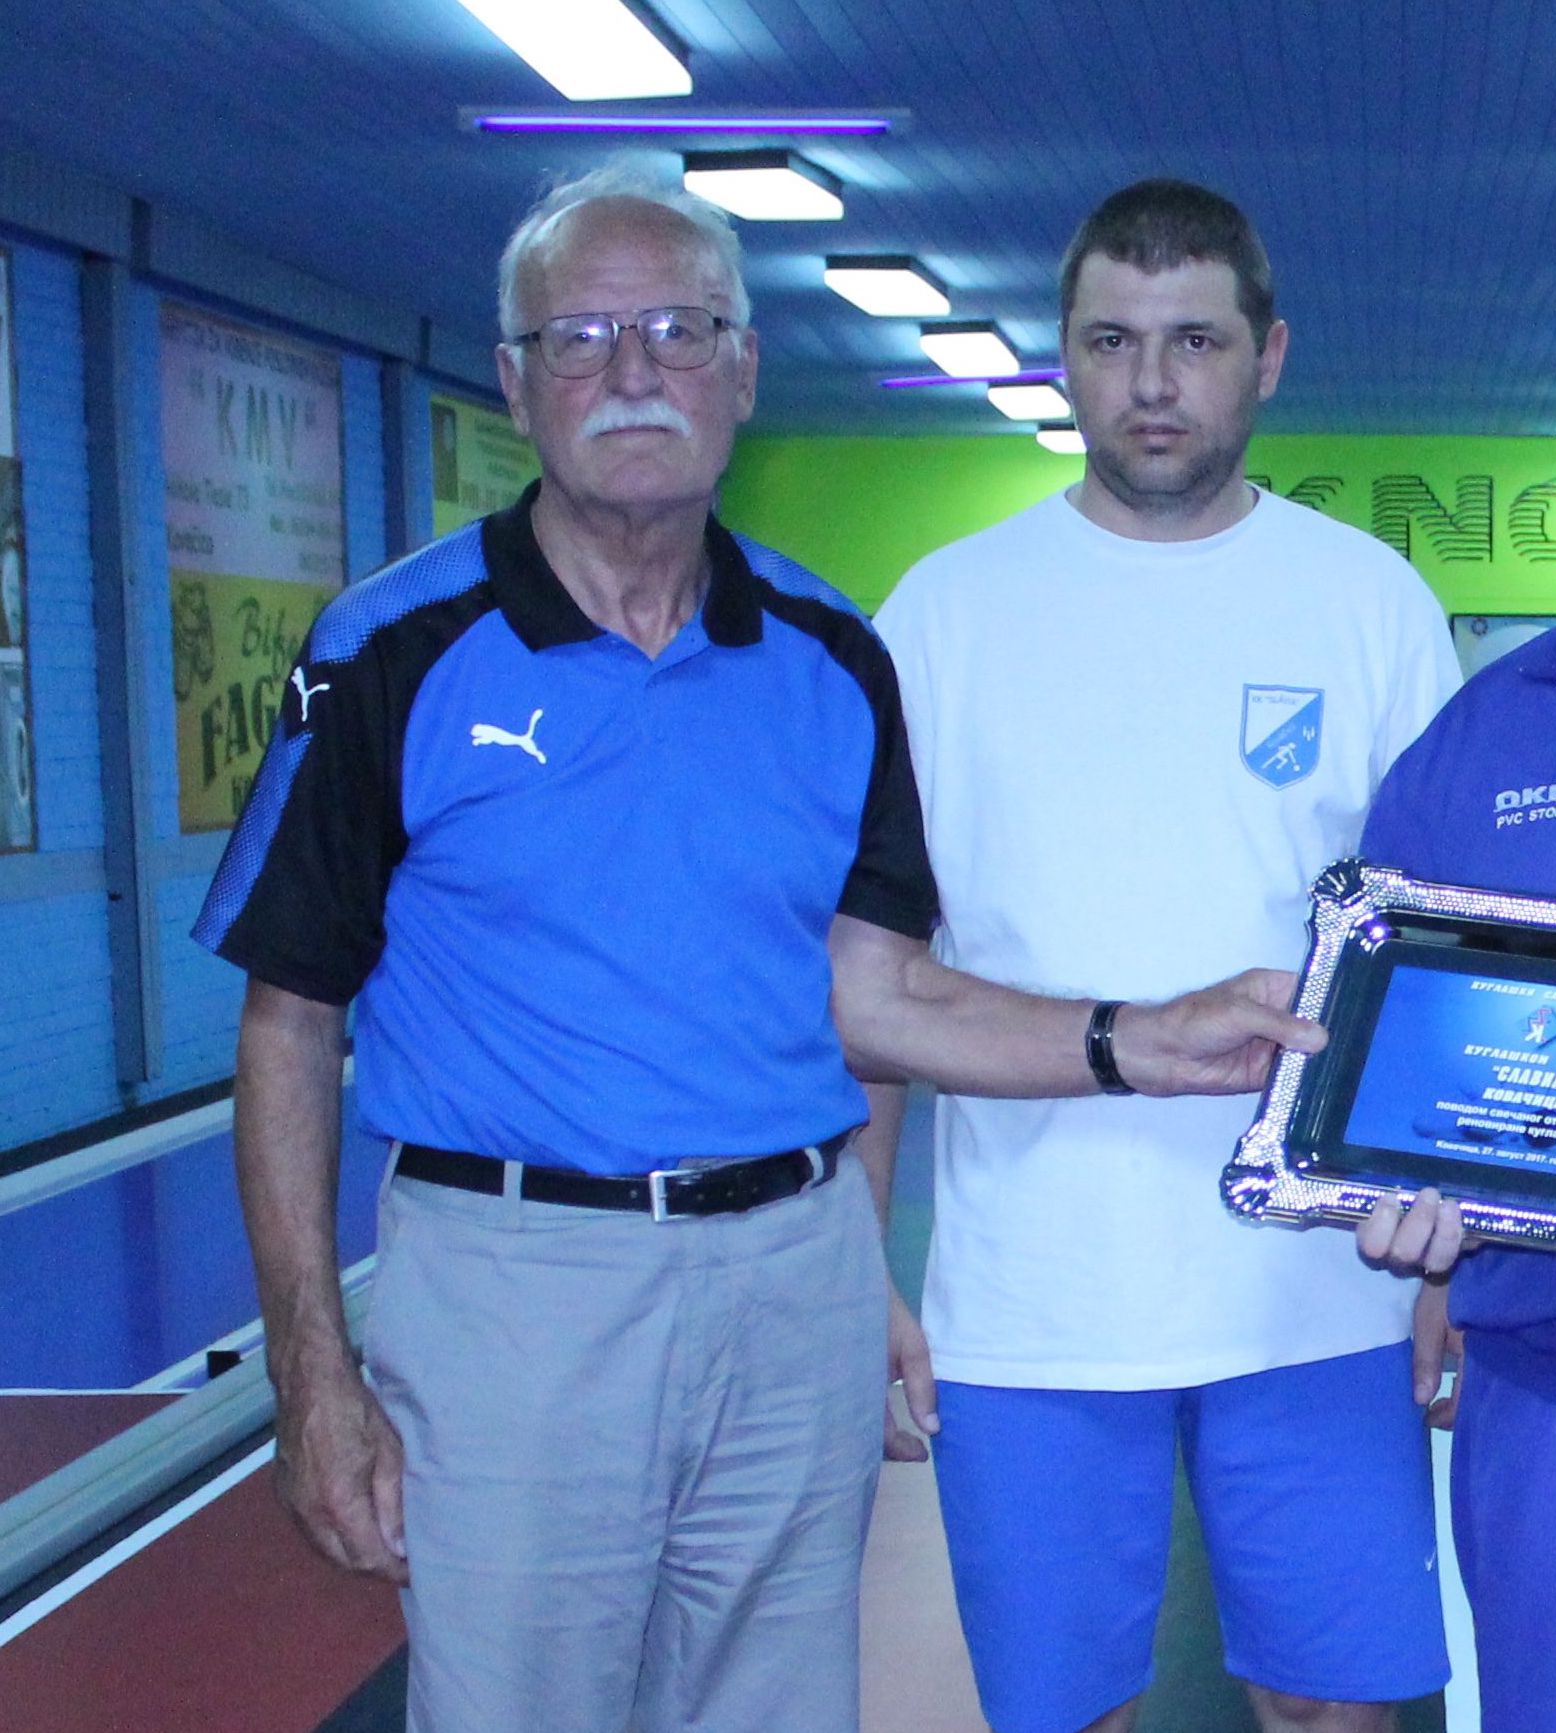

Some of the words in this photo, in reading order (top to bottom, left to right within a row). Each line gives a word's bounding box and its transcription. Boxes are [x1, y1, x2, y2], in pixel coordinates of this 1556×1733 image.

[202, 674, 281, 790] FAG
[1496, 812, 1523, 829] PVC
[1463, 1044, 1550, 1066] КУГЛАШКОМ
[1435, 1101, 1488, 1116] поводом
[1489, 1108, 1543, 1124] свечаног
[1456, 1116, 1527, 1134] реновиране
